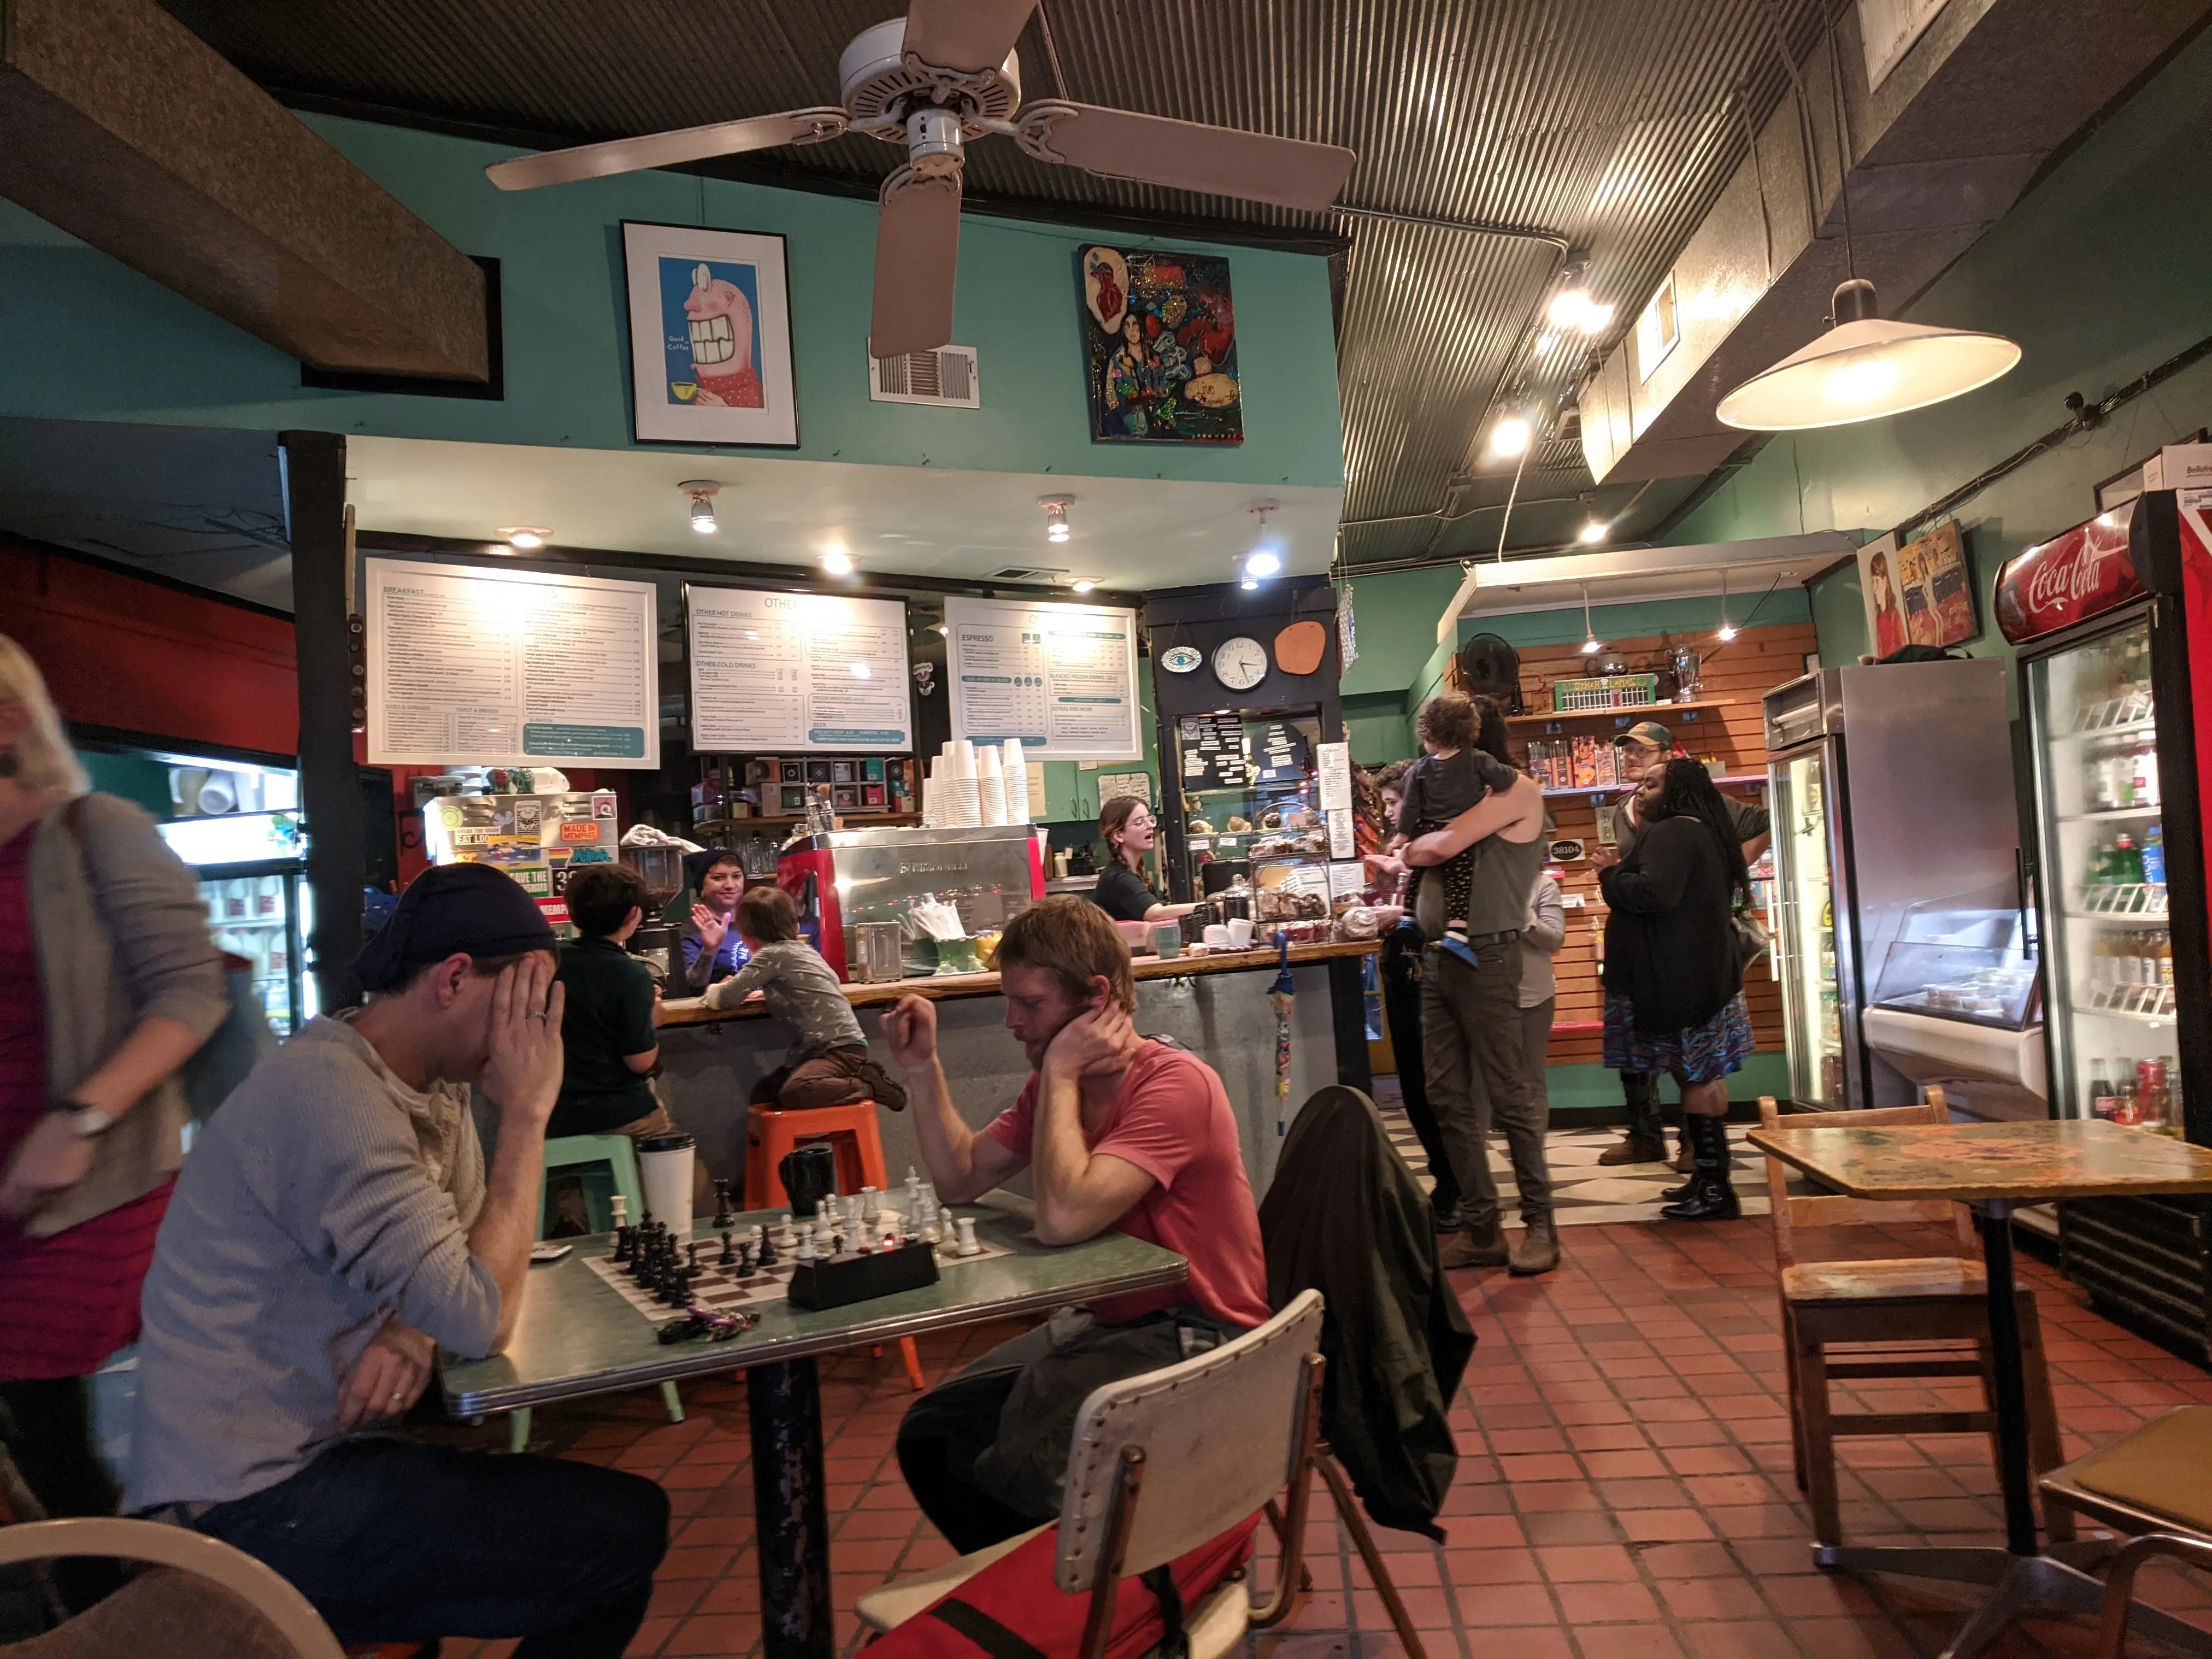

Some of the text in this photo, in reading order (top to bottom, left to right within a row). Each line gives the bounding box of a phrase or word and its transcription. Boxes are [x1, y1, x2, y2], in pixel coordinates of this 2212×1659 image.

[668, 334, 685, 342] Good
[2028, 546, 2101, 614] Coca-Cola
[383, 586, 425, 596] BREAKFAST
[962, 634, 994, 643] ESPRESSO
[563, 824, 587, 832] MADE
[459, 835, 472, 844] EAT
[563, 832, 596, 840] MEMPHIS
[1552, 845, 1580, 855] 38104
[531, 871, 548, 883] THE
